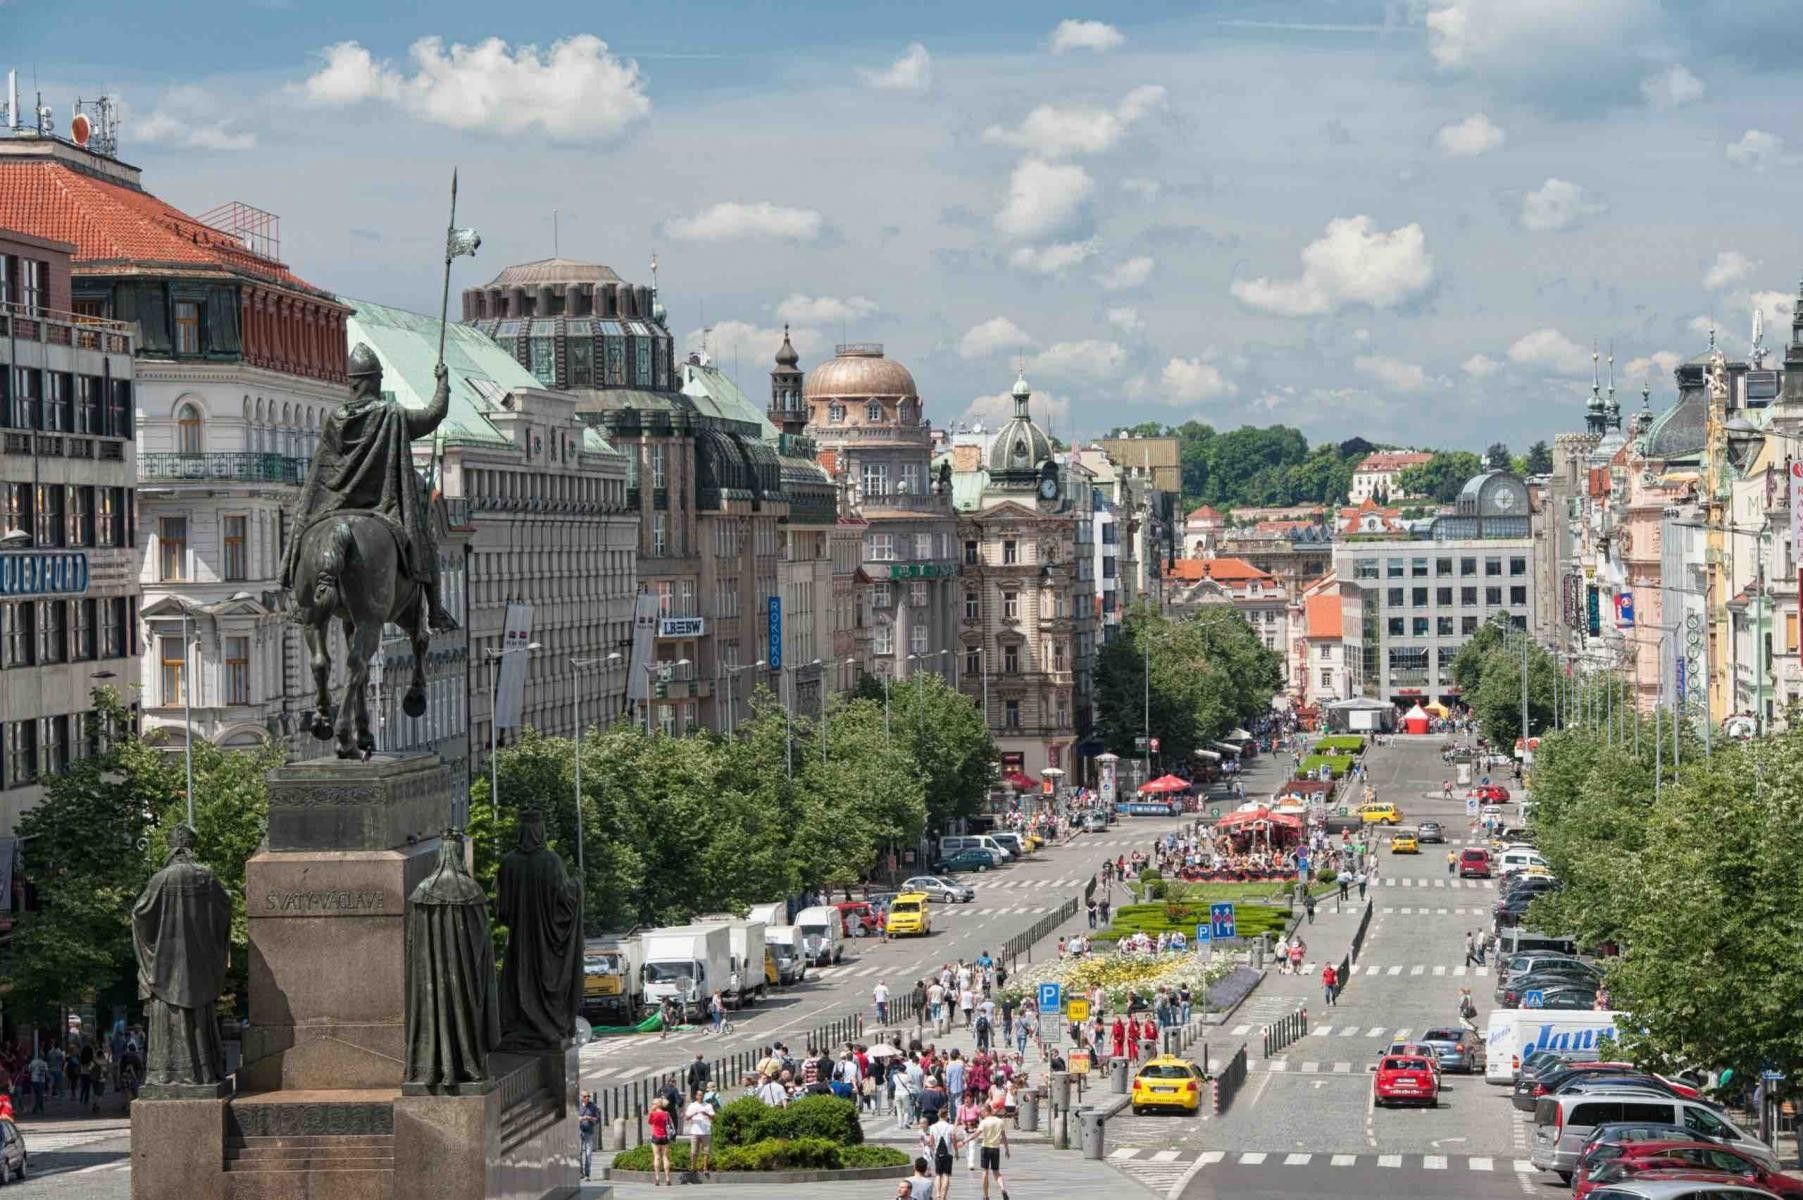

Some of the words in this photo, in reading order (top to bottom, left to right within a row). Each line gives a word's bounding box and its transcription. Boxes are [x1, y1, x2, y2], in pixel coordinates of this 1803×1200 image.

[1590, 594, 1598, 629] GATE
[770, 600, 780, 666] ROKOKO
[1199, 927, 1208, 938] P
[1043, 986, 1055, 1004] P
[1072, 1006, 1085, 1014] TAXI
